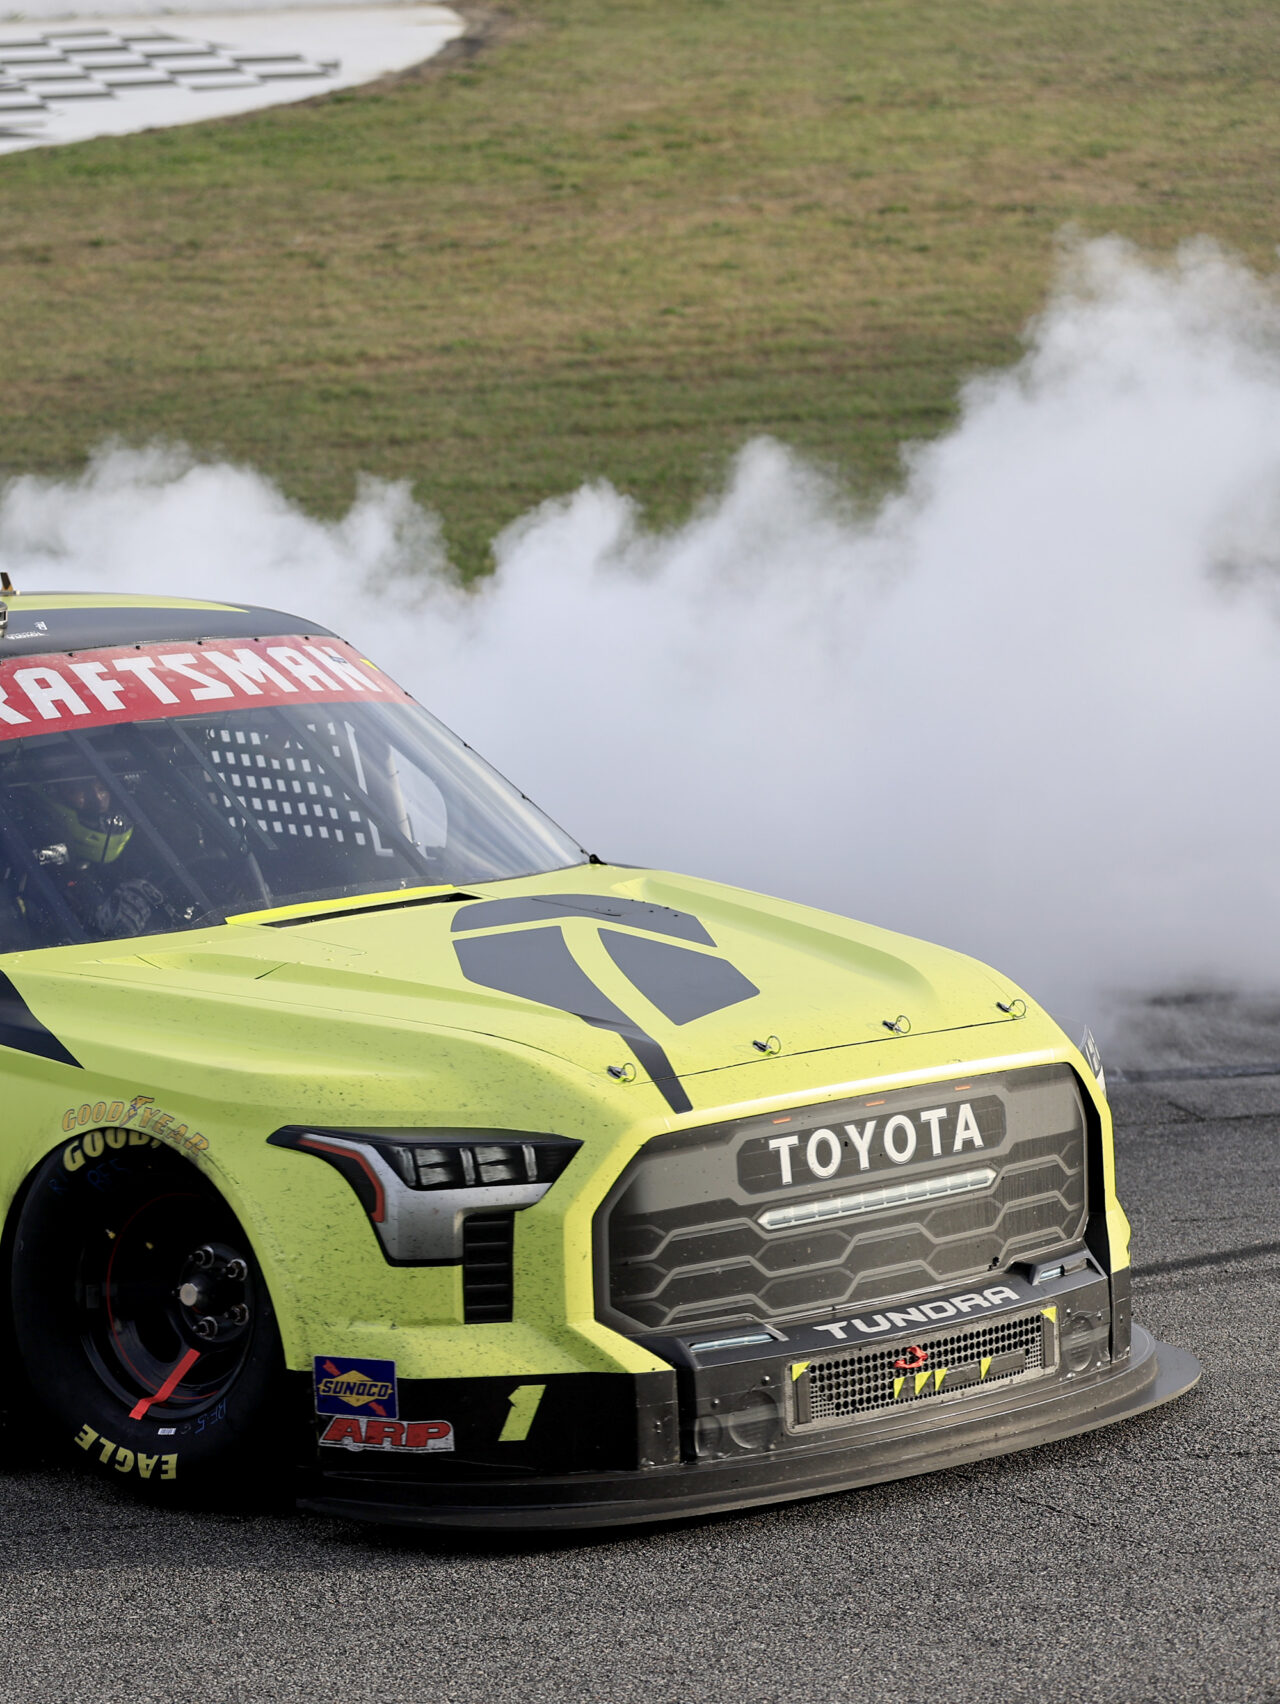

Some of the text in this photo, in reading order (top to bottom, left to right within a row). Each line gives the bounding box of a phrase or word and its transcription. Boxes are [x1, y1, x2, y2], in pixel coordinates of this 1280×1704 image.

[62, 1095, 210, 1157] GOODYEAR
[768, 1102, 985, 1186] TOYOTA
[813, 1286, 1021, 1340] TUNDRA
[321, 1379, 390, 1399] SUNOCO
[498, 1384, 547, 1442] 1
[74, 1422, 178, 1480] EAGLE
[322, 1417, 452, 1447] ARP
